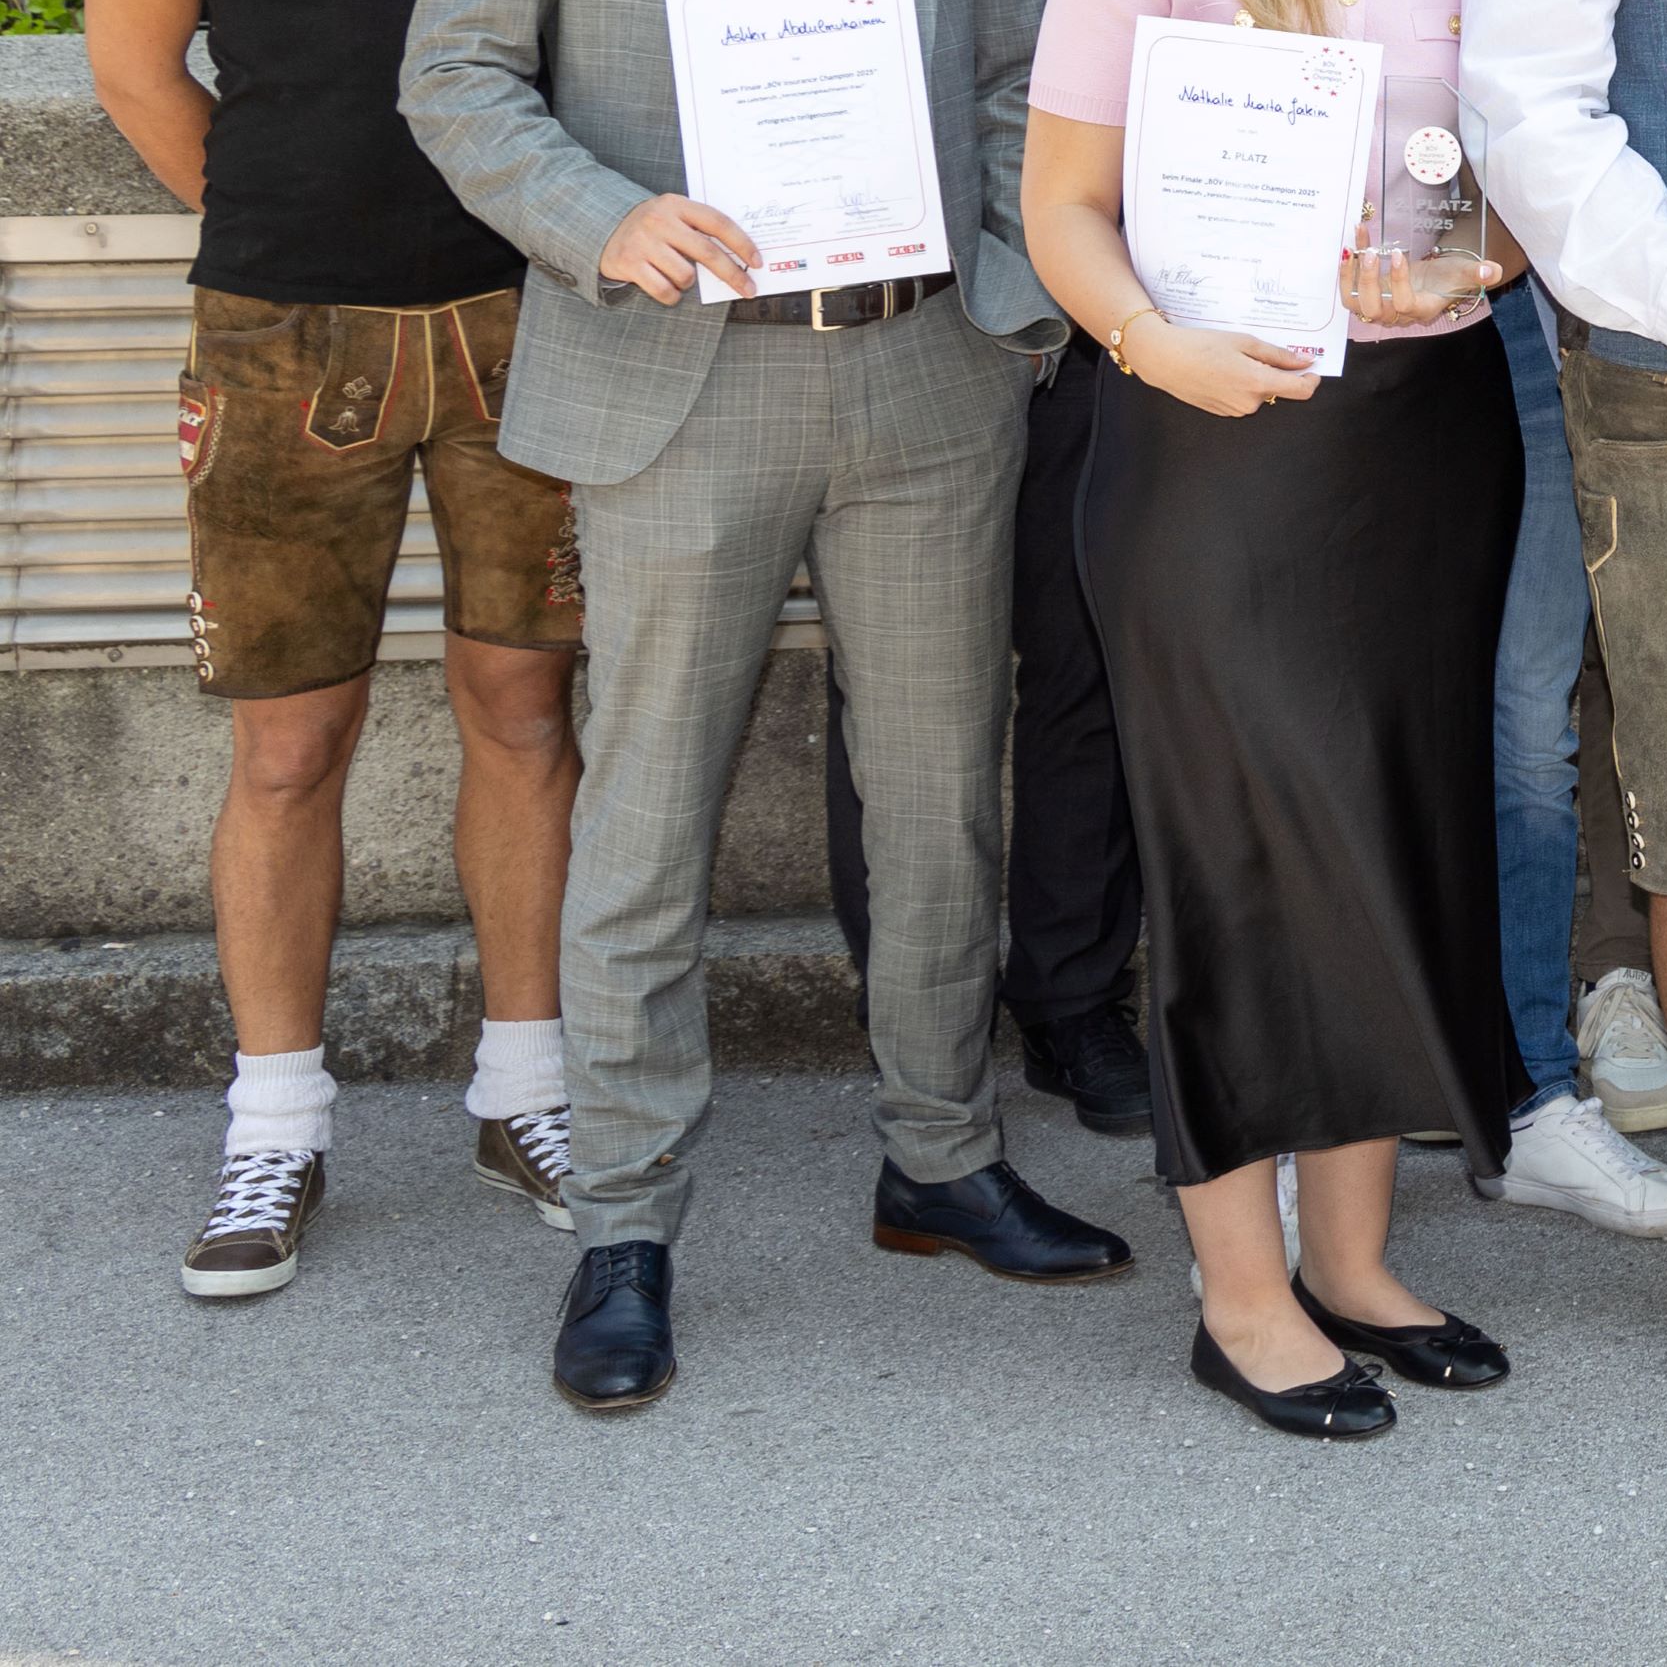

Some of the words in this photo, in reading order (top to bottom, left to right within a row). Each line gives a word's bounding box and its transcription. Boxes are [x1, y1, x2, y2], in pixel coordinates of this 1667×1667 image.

[1178, 84, 1235, 106] Nathalie
[1221, 150, 1232, 159] 2.
[1235, 151, 1267, 163] PLATZ
[1416, 200, 1472, 211] PLATZ
[1414, 219, 1453, 229] 2025
